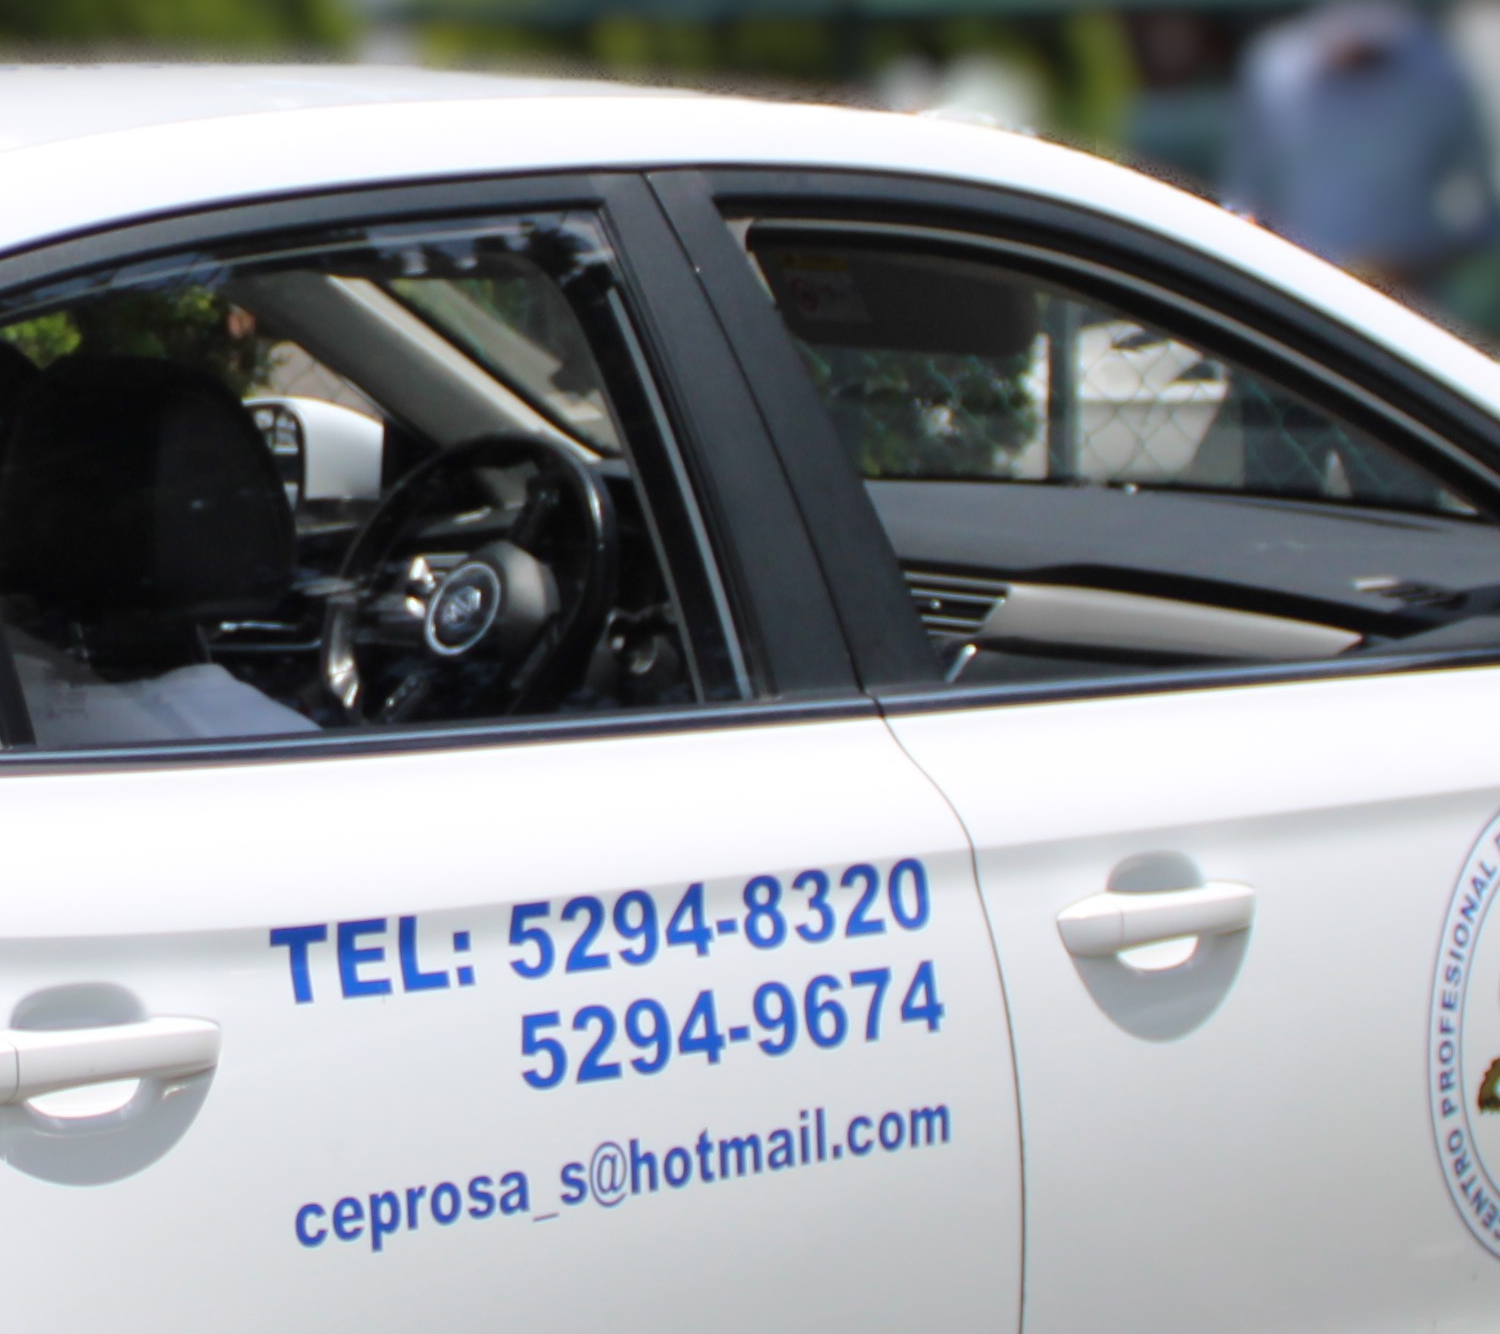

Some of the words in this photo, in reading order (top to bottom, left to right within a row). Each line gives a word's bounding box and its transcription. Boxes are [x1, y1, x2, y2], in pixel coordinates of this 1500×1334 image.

[270, 914, 476, 1004] TEL:
[508, 857, 931, 979] 5294-8320
[1439, 862, 1497, 1118] PROFESIONAL
[520, 959, 945, 1089] 5294-9674
[294, 1103, 952, 1252] ceprosa_s@hotmail.com
